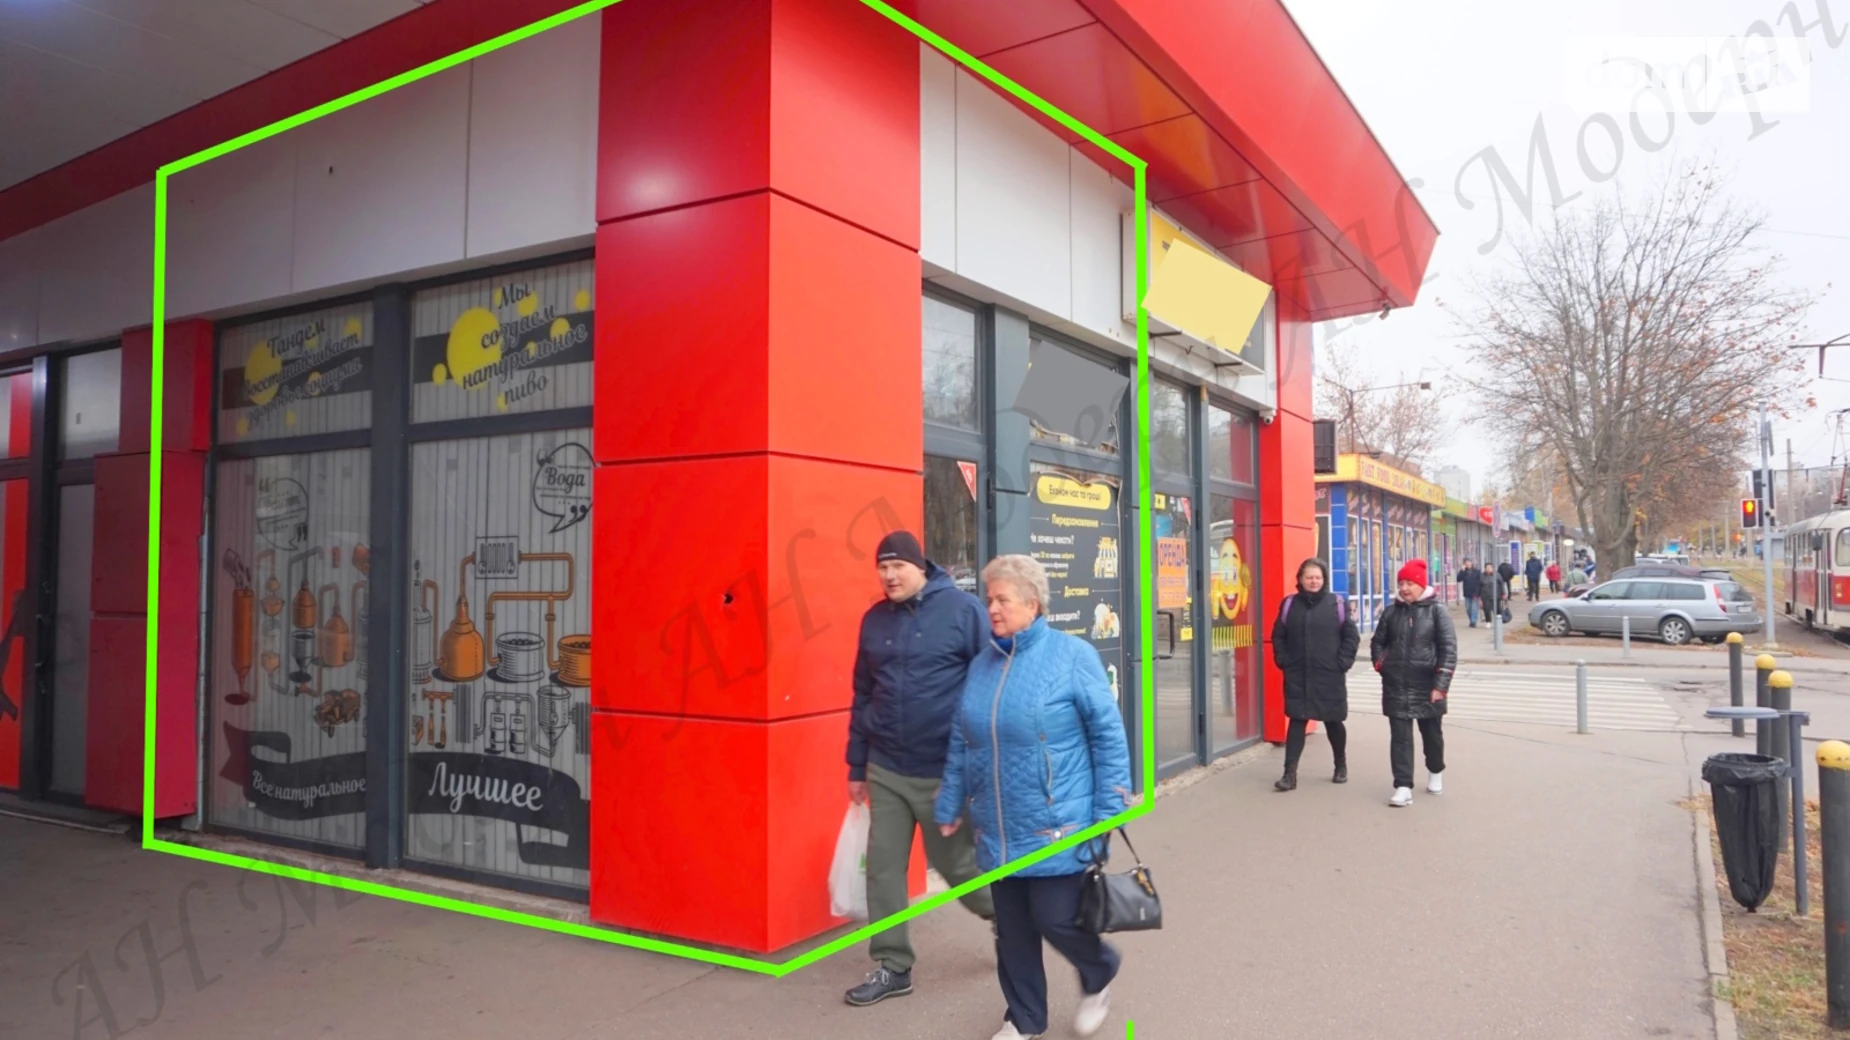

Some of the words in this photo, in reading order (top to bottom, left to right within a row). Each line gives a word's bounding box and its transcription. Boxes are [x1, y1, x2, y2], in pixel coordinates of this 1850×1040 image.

[498, 283, 531, 309] Мы
[266, 318, 327, 358] Тандем
[481, 304, 557, 352] создаем
[462, 323, 588, 391] натуральное
[504, 369, 549, 405] пиво
[545, 466, 587, 494] Вода
[252, 769, 274, 797] Все
[274, 778, 367, 809] натуральное
[427, 761, 544, 814] Лучшее
